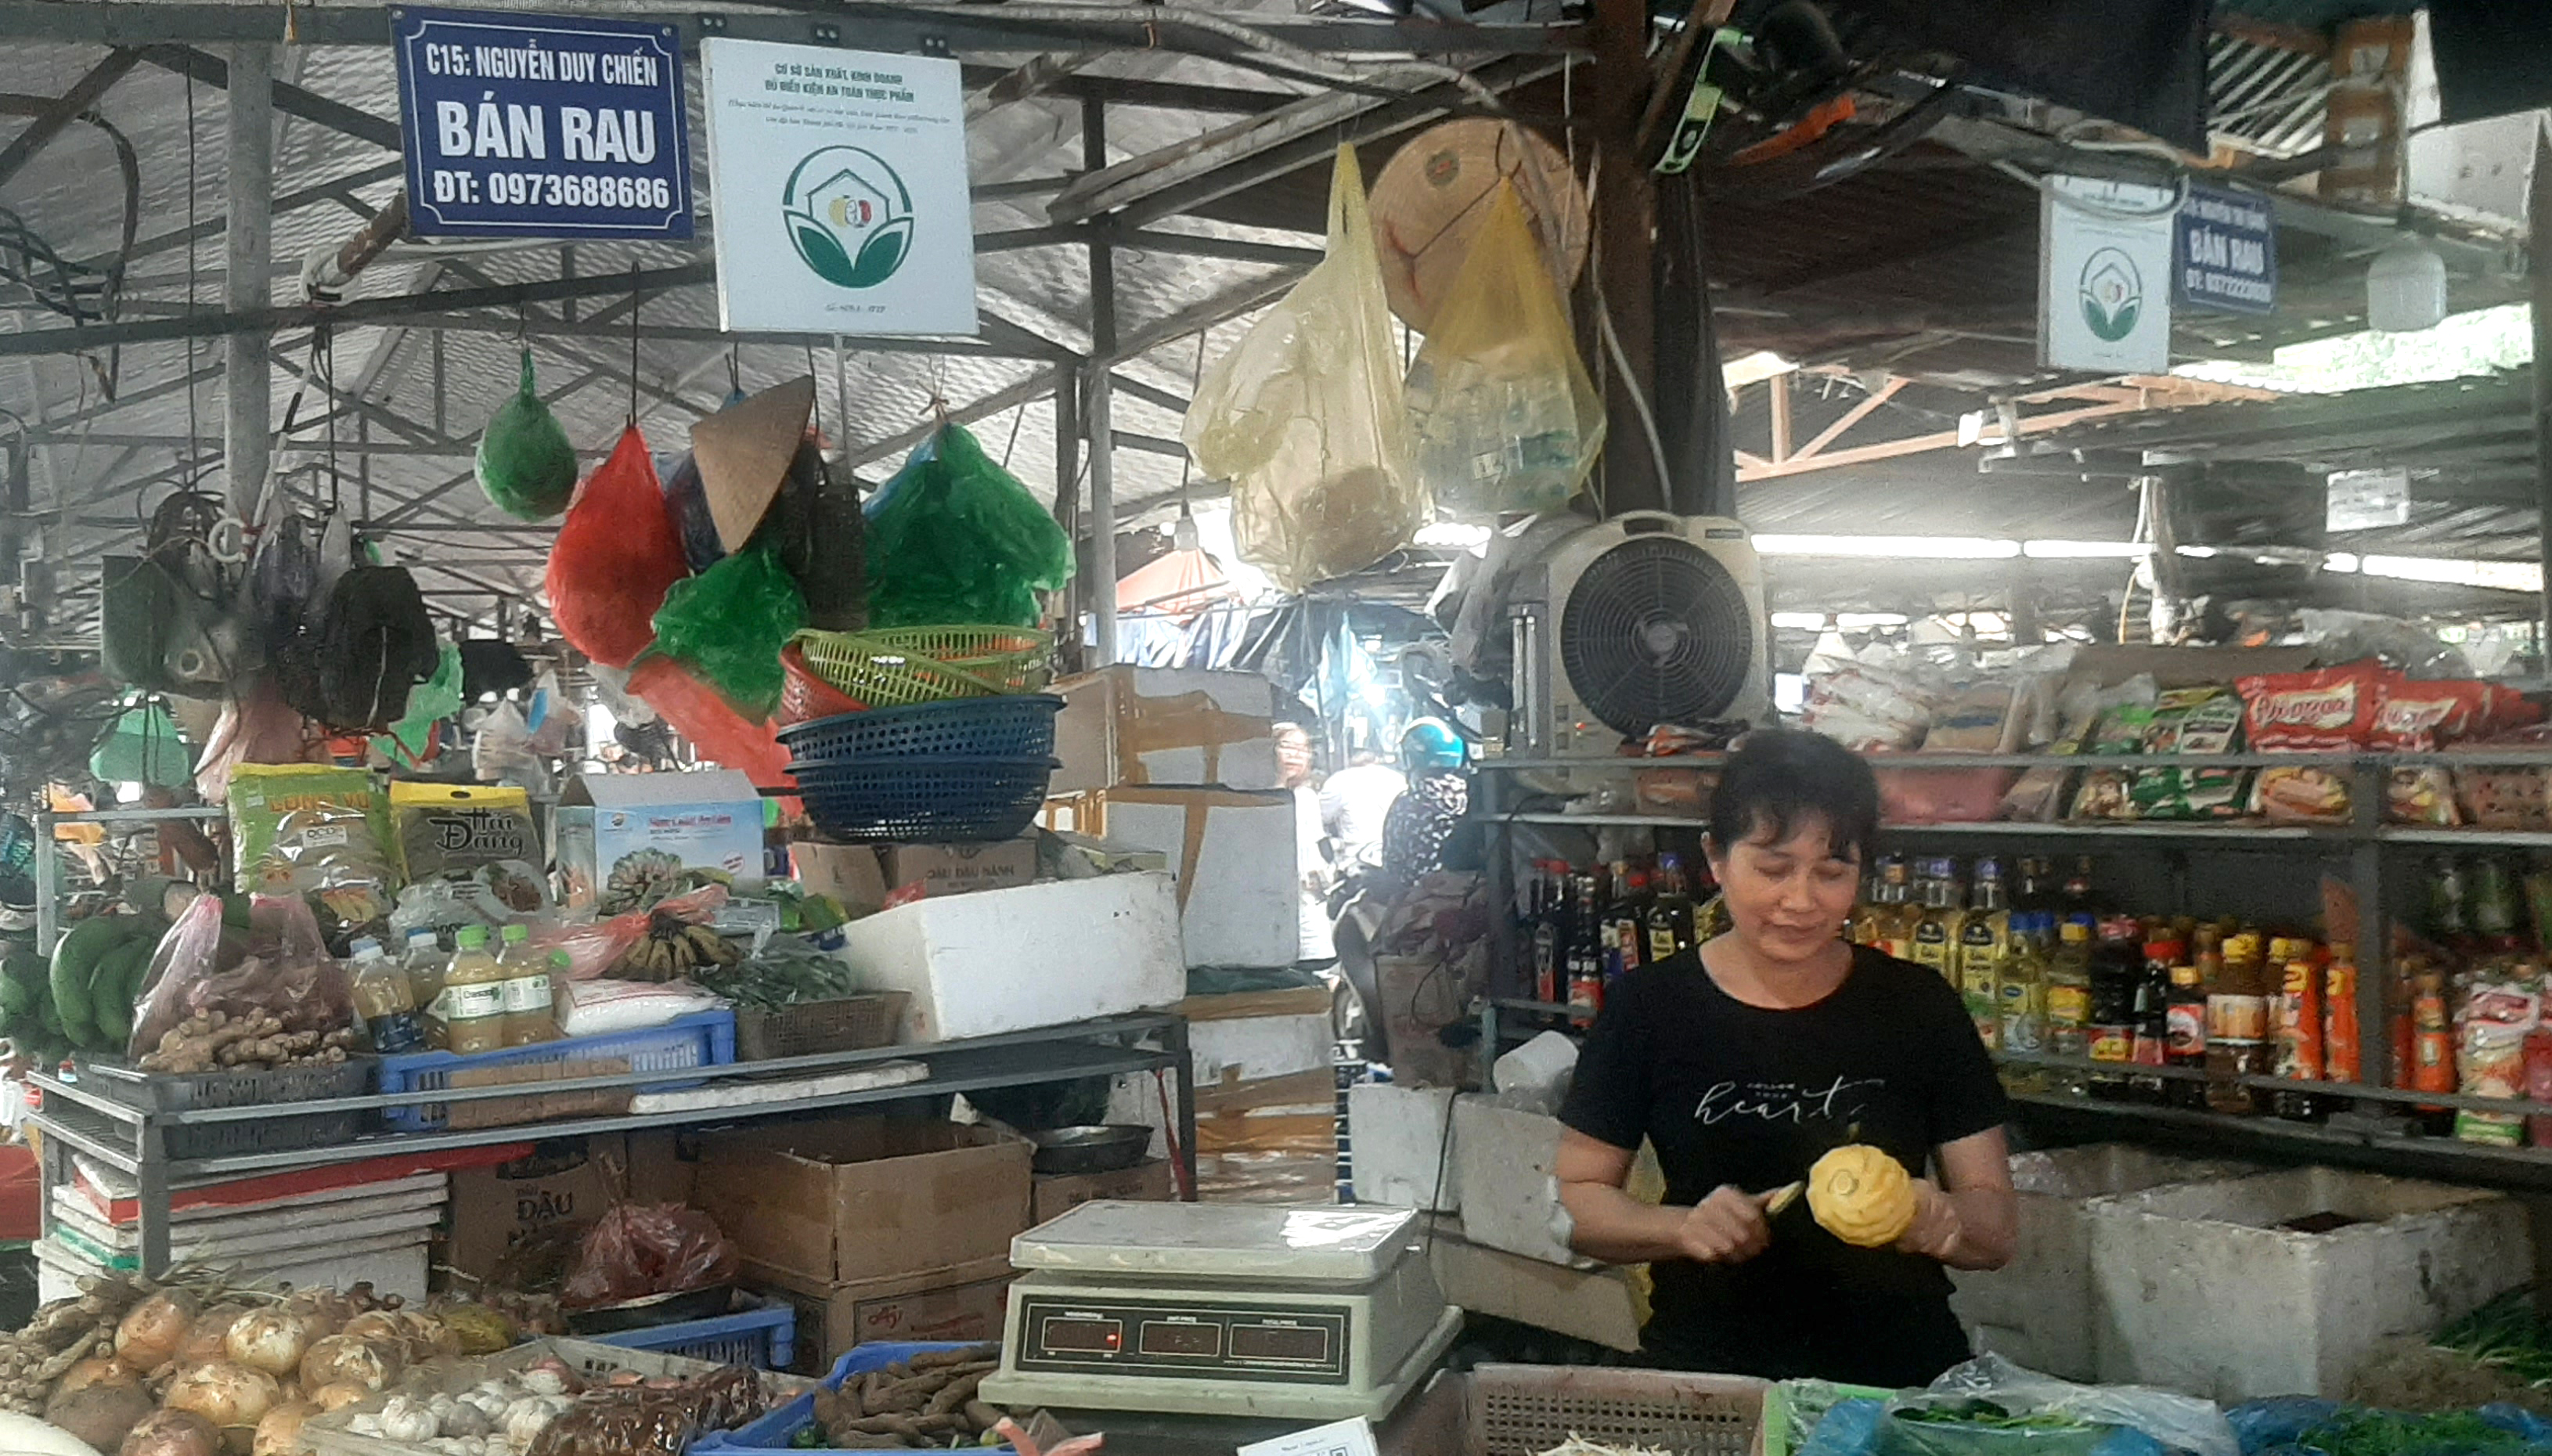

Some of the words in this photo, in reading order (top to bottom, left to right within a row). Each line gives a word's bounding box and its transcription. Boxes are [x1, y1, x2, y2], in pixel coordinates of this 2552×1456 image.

[425, 42, 471, 77] C15:
[474, 38, 557, 81] NGUYỄN
[558, 51, 597, 83] DUY
[601, 45, 659, 88] CHIẾN
[436, 90, 546, 160] BÁN
[561, 106, 657, 164] RAU
[433, 170, 480, 204] ĐT:
[488, 172, 670, 209] 0973688686
